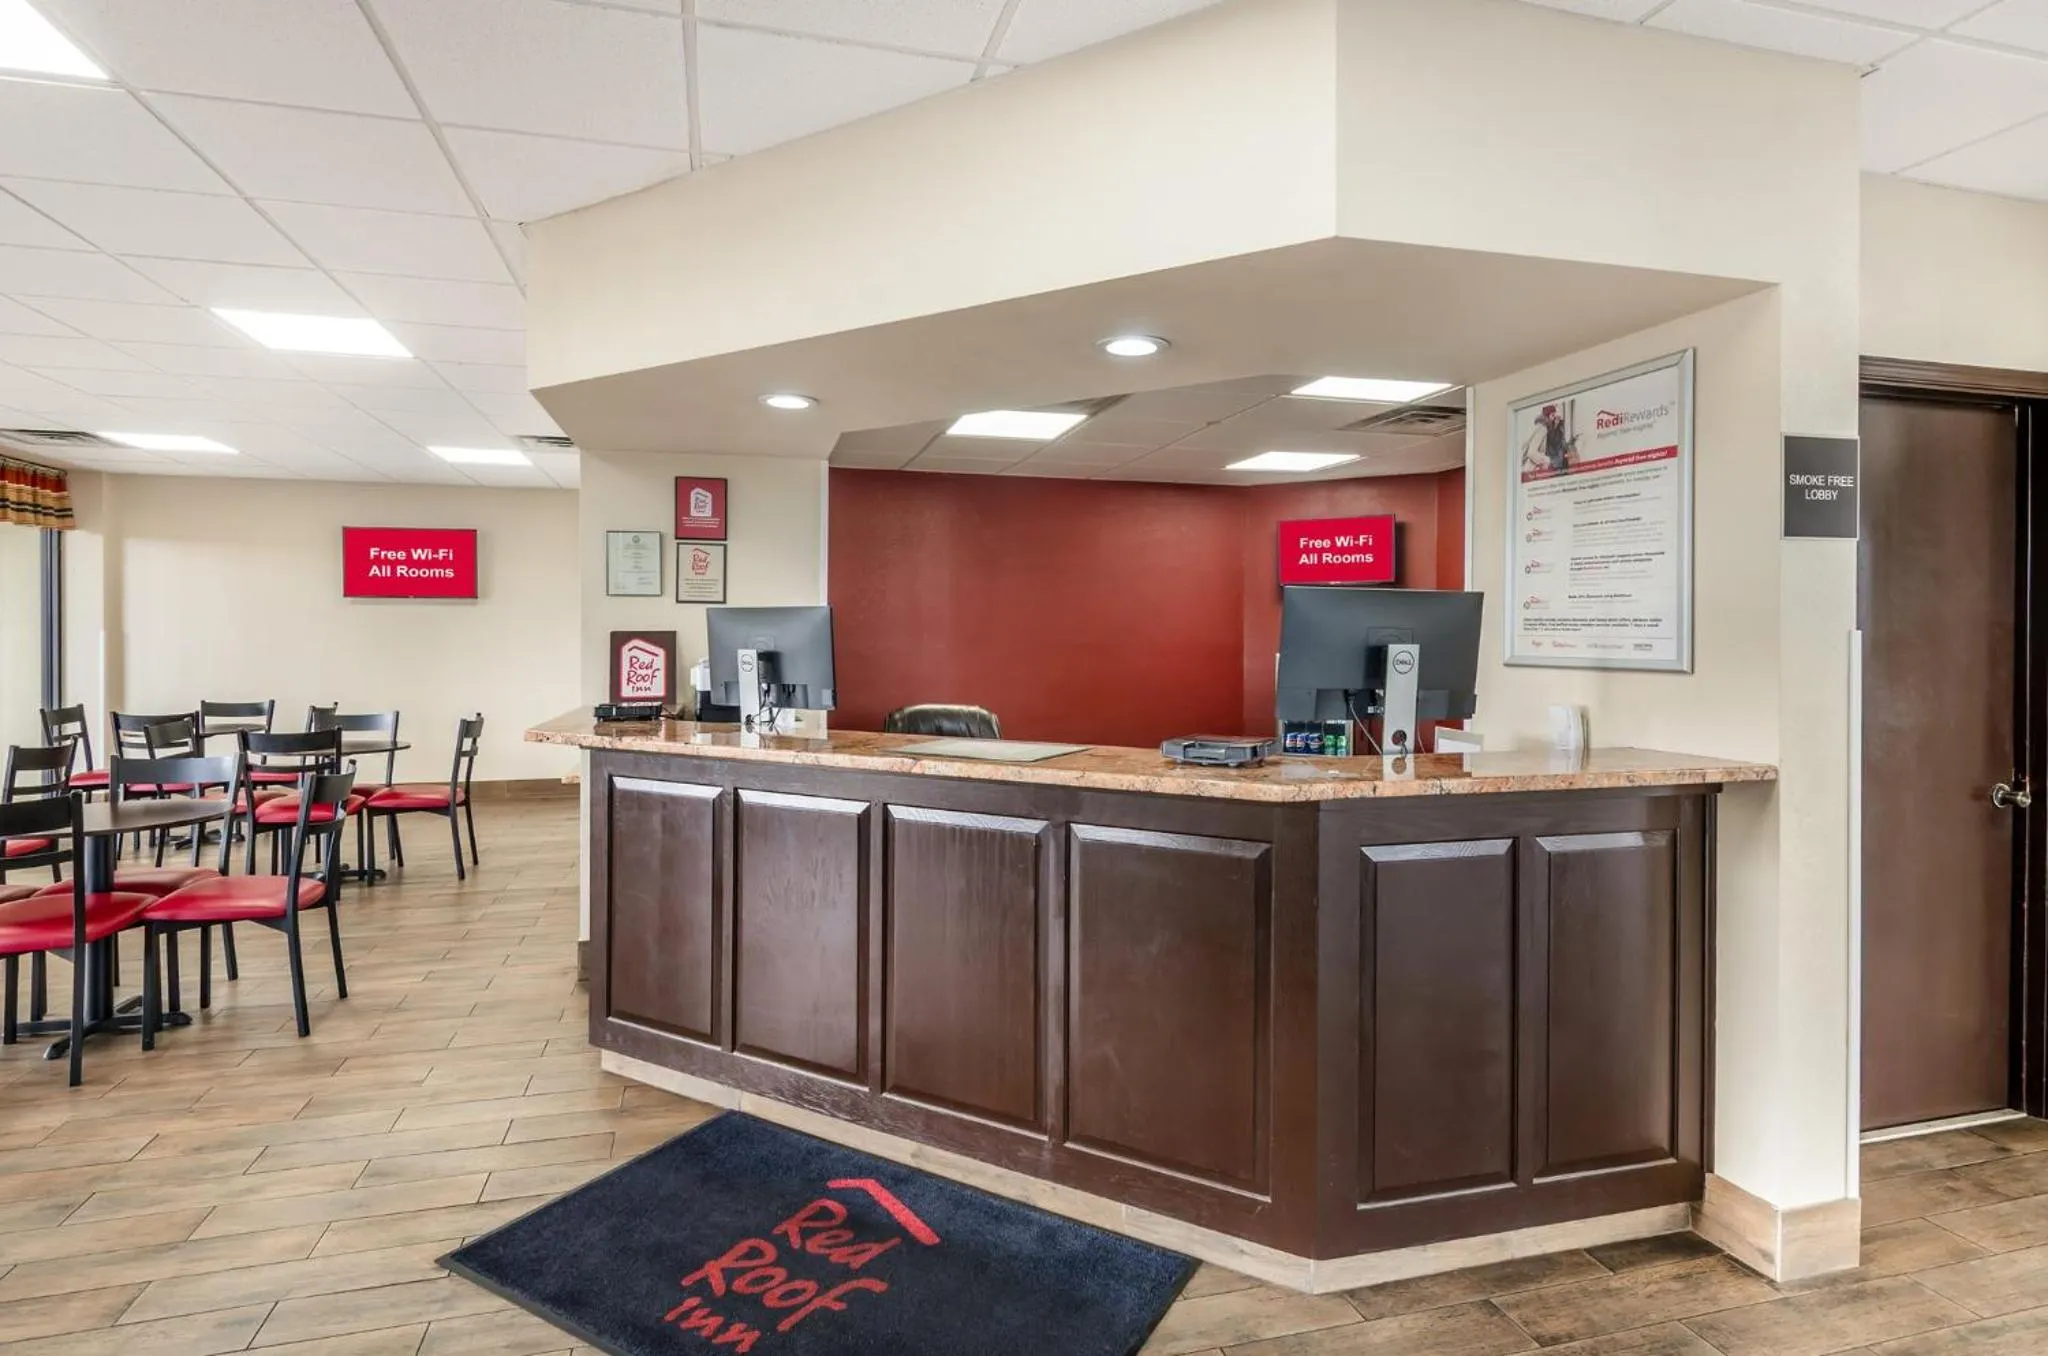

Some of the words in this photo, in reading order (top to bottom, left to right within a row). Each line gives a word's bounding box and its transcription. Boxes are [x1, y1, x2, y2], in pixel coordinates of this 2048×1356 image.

[1789, 474, 1825, 486] SMOKE
[1827, 475, 1854, 487] FREE
[1805, 489, 1839, 500] LOBBY
[1300, 537, 1331, 549] Free
[1335, 535, 1373, 547] Wi-Fi
[369, 547, 406, 560] Free
[411, 548, 453, 560] Wi-Fi
[1299, 553, 1318, 565] All
[1322, 552, 1374, 564] Rooms
[368, 565, 391, 577] All
[397, 565, 454, 578] Rooms
[629, 655, 654, 670] Red
[627, 668, 660, 686] Roof
[771, 1197, 902, 1270] Red
[680, 1237, 889, 1333] Roof
[663, 1296, 762, 1355] Inn
